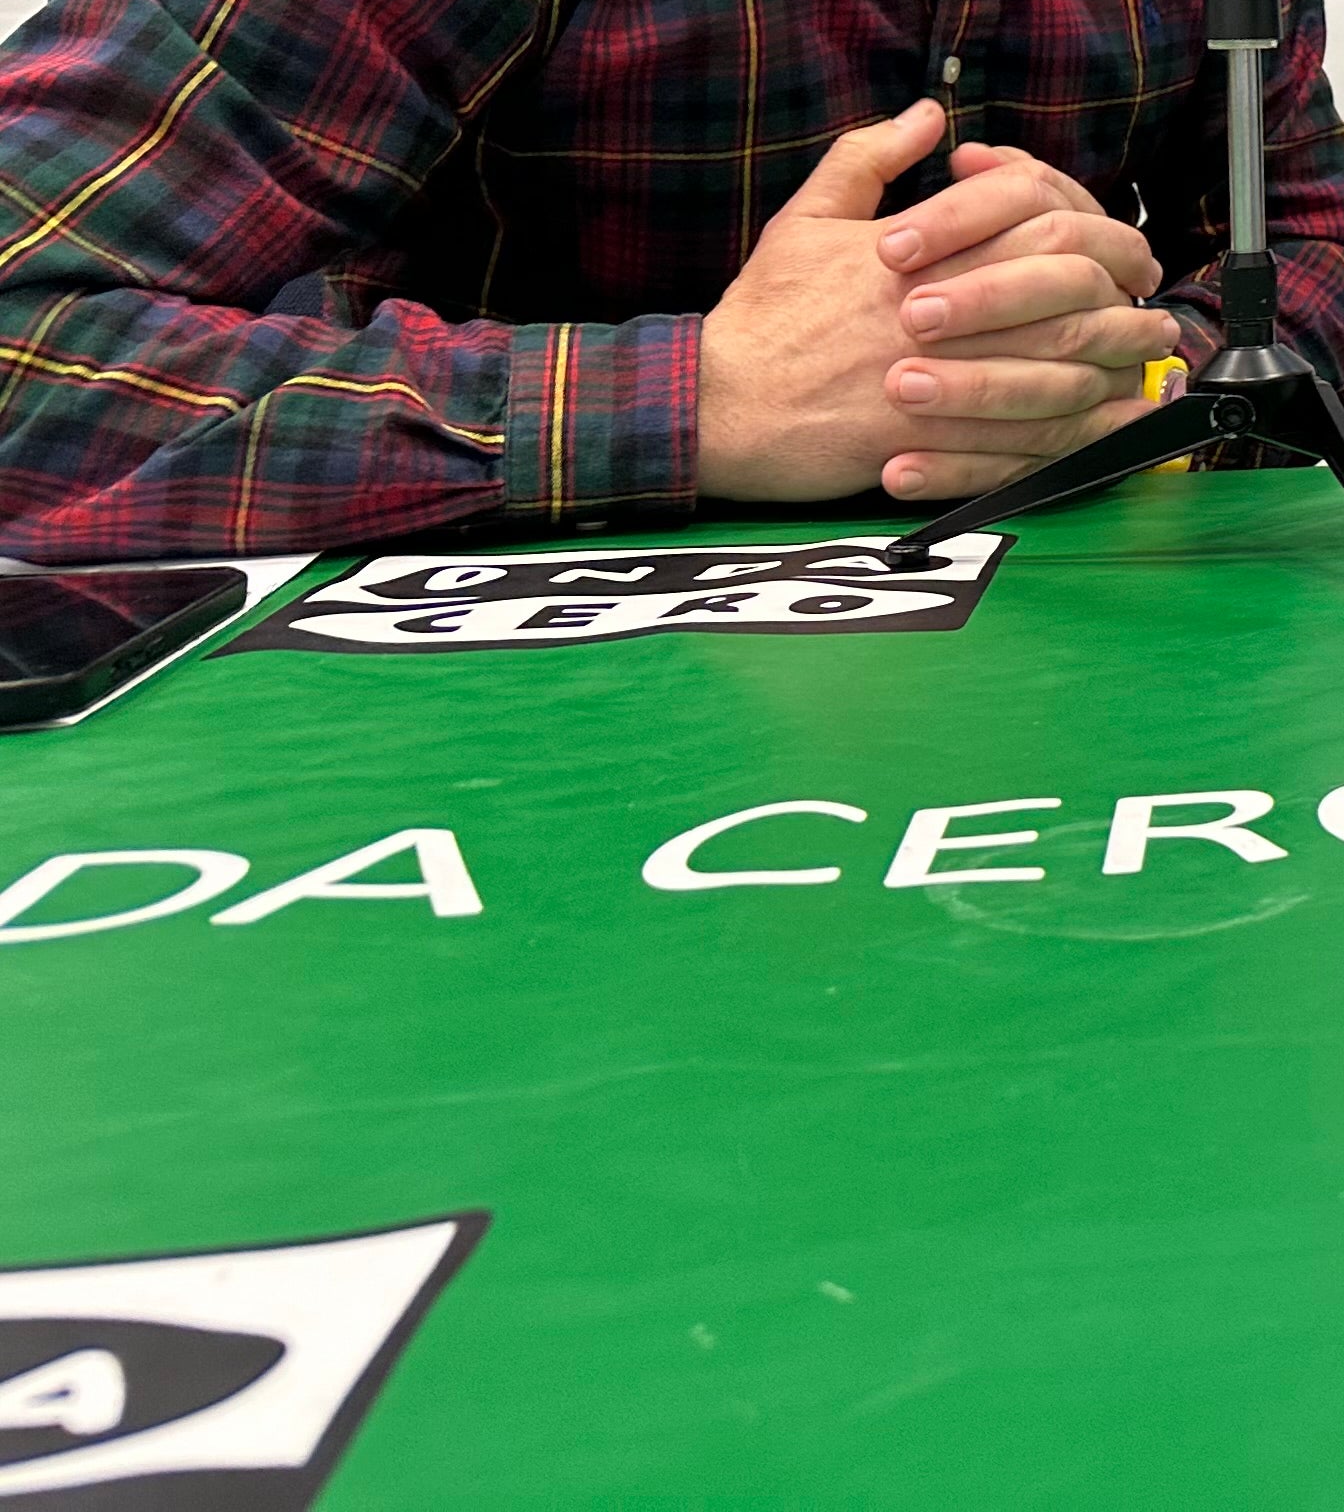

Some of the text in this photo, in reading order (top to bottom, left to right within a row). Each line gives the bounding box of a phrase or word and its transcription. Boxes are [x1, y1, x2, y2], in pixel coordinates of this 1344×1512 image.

[425, 554, 892, 590] ONDA
[394, 592, 875, 634] CERO
[0, 828, 482, 943] DA
